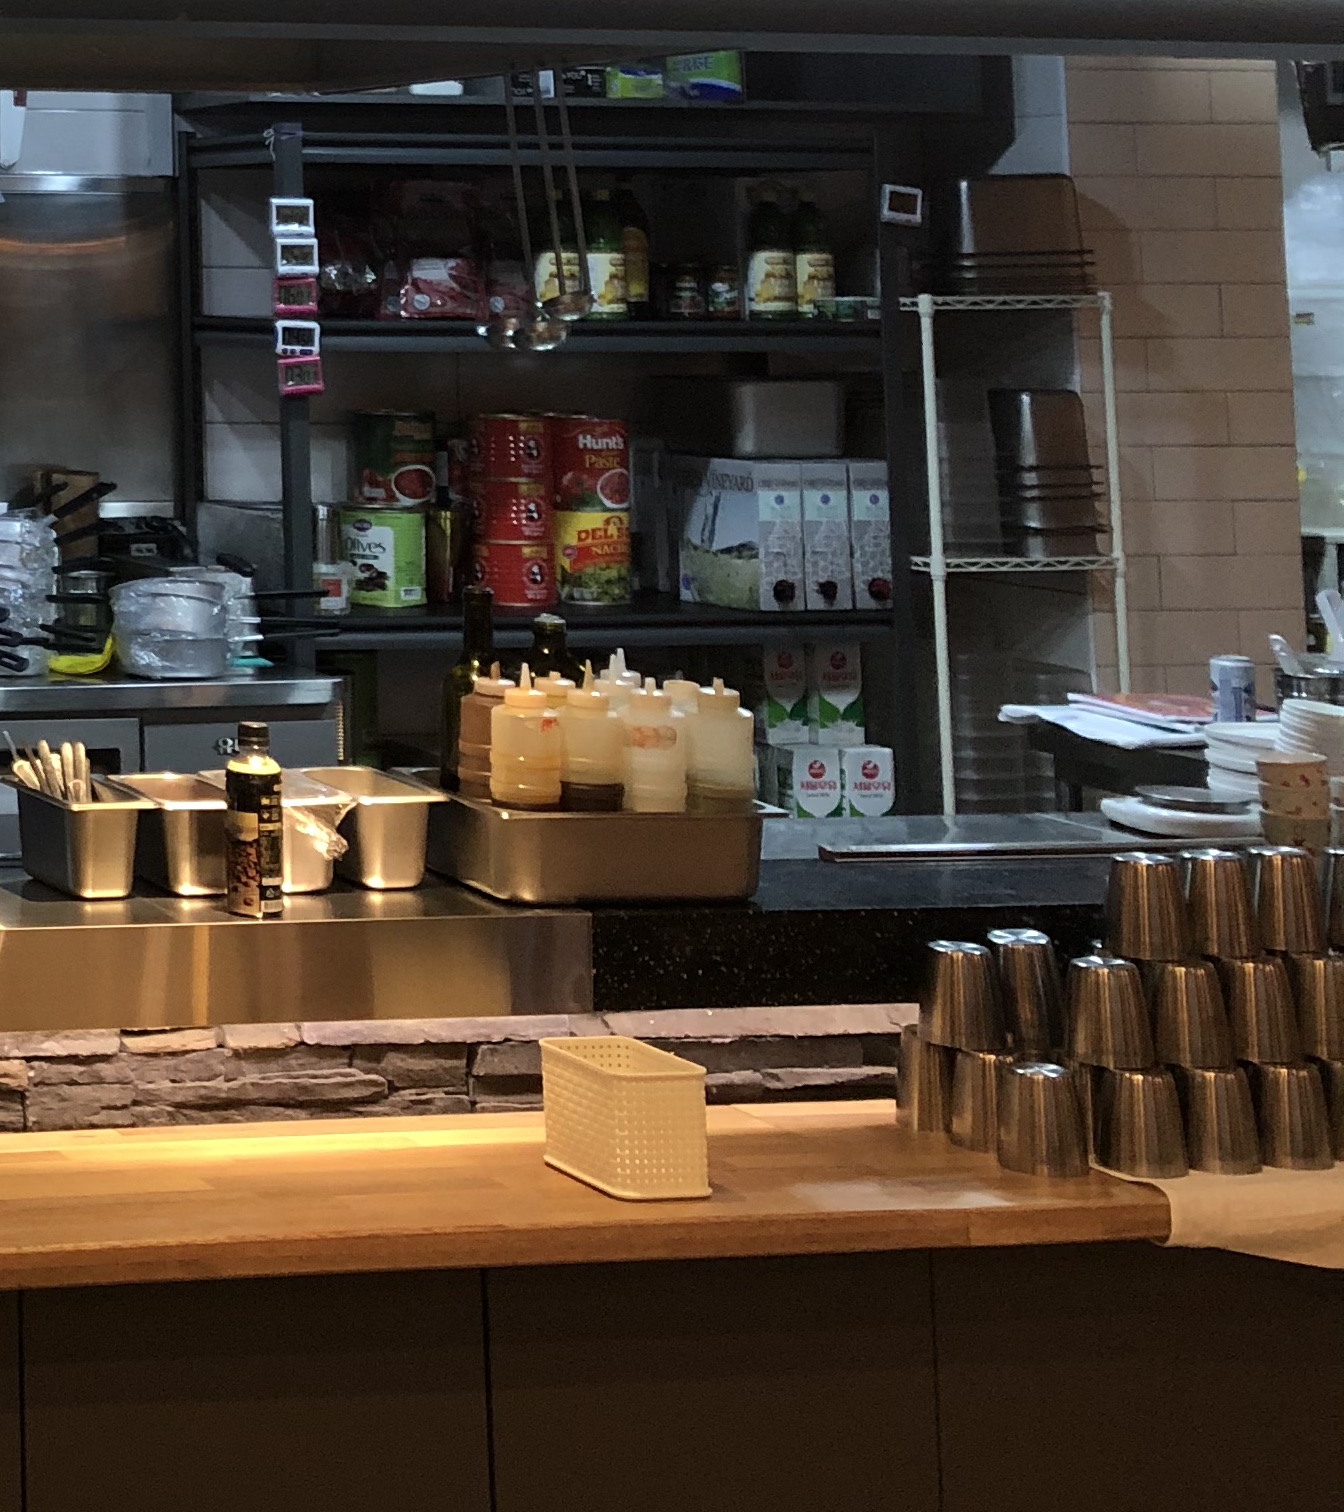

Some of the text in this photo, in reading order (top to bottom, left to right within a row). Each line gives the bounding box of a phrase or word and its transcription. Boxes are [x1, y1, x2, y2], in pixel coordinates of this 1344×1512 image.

[577, 433, 625, 451] Hunt's
[584, 453, 621, 470] Paste
[344, 537, 387, 555] Olives
